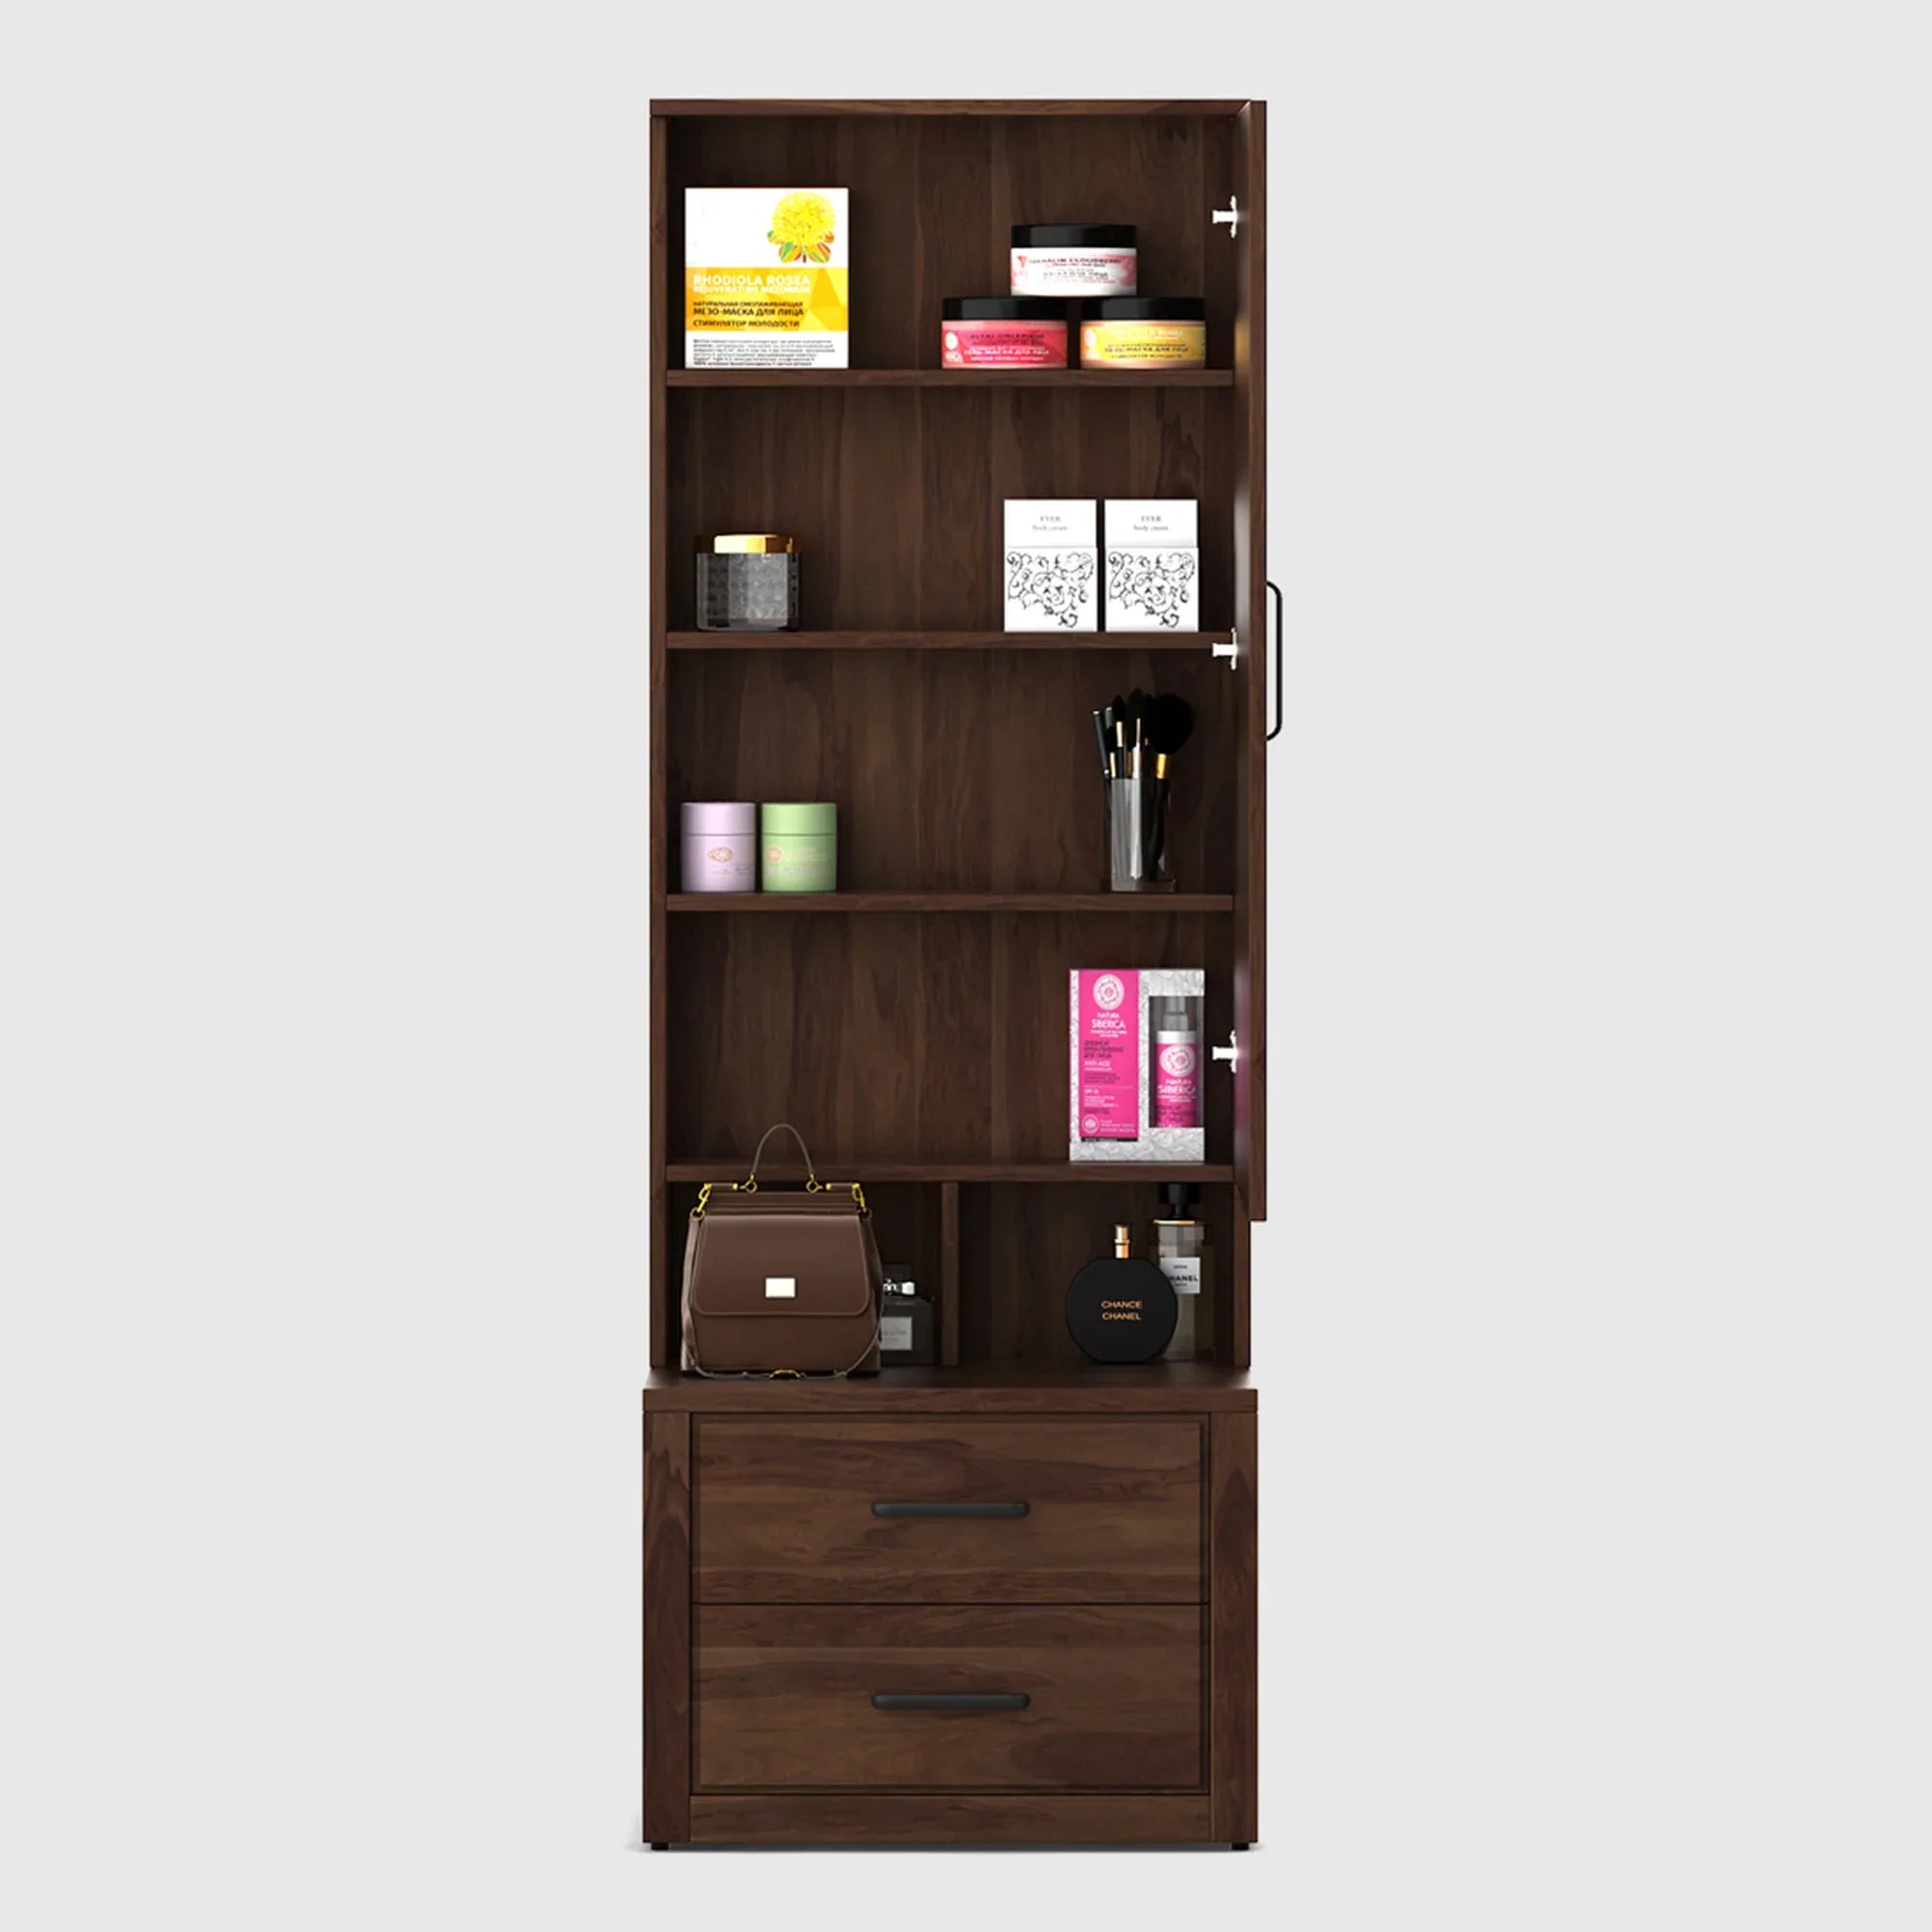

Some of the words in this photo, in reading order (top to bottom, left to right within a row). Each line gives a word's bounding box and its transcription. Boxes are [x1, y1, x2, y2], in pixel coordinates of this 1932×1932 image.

[693, 274, 763, 286] RHODIOLA
[766, 274, 810, 286] ROSEA
[755, 308, 776, 317] ДЛЯ
[778, 308, 805, 317] ЛИЦА
[1101, 1300, 1144, 1309] CHANCE
[1102, 1312, 1142, 1321] CHANEL
